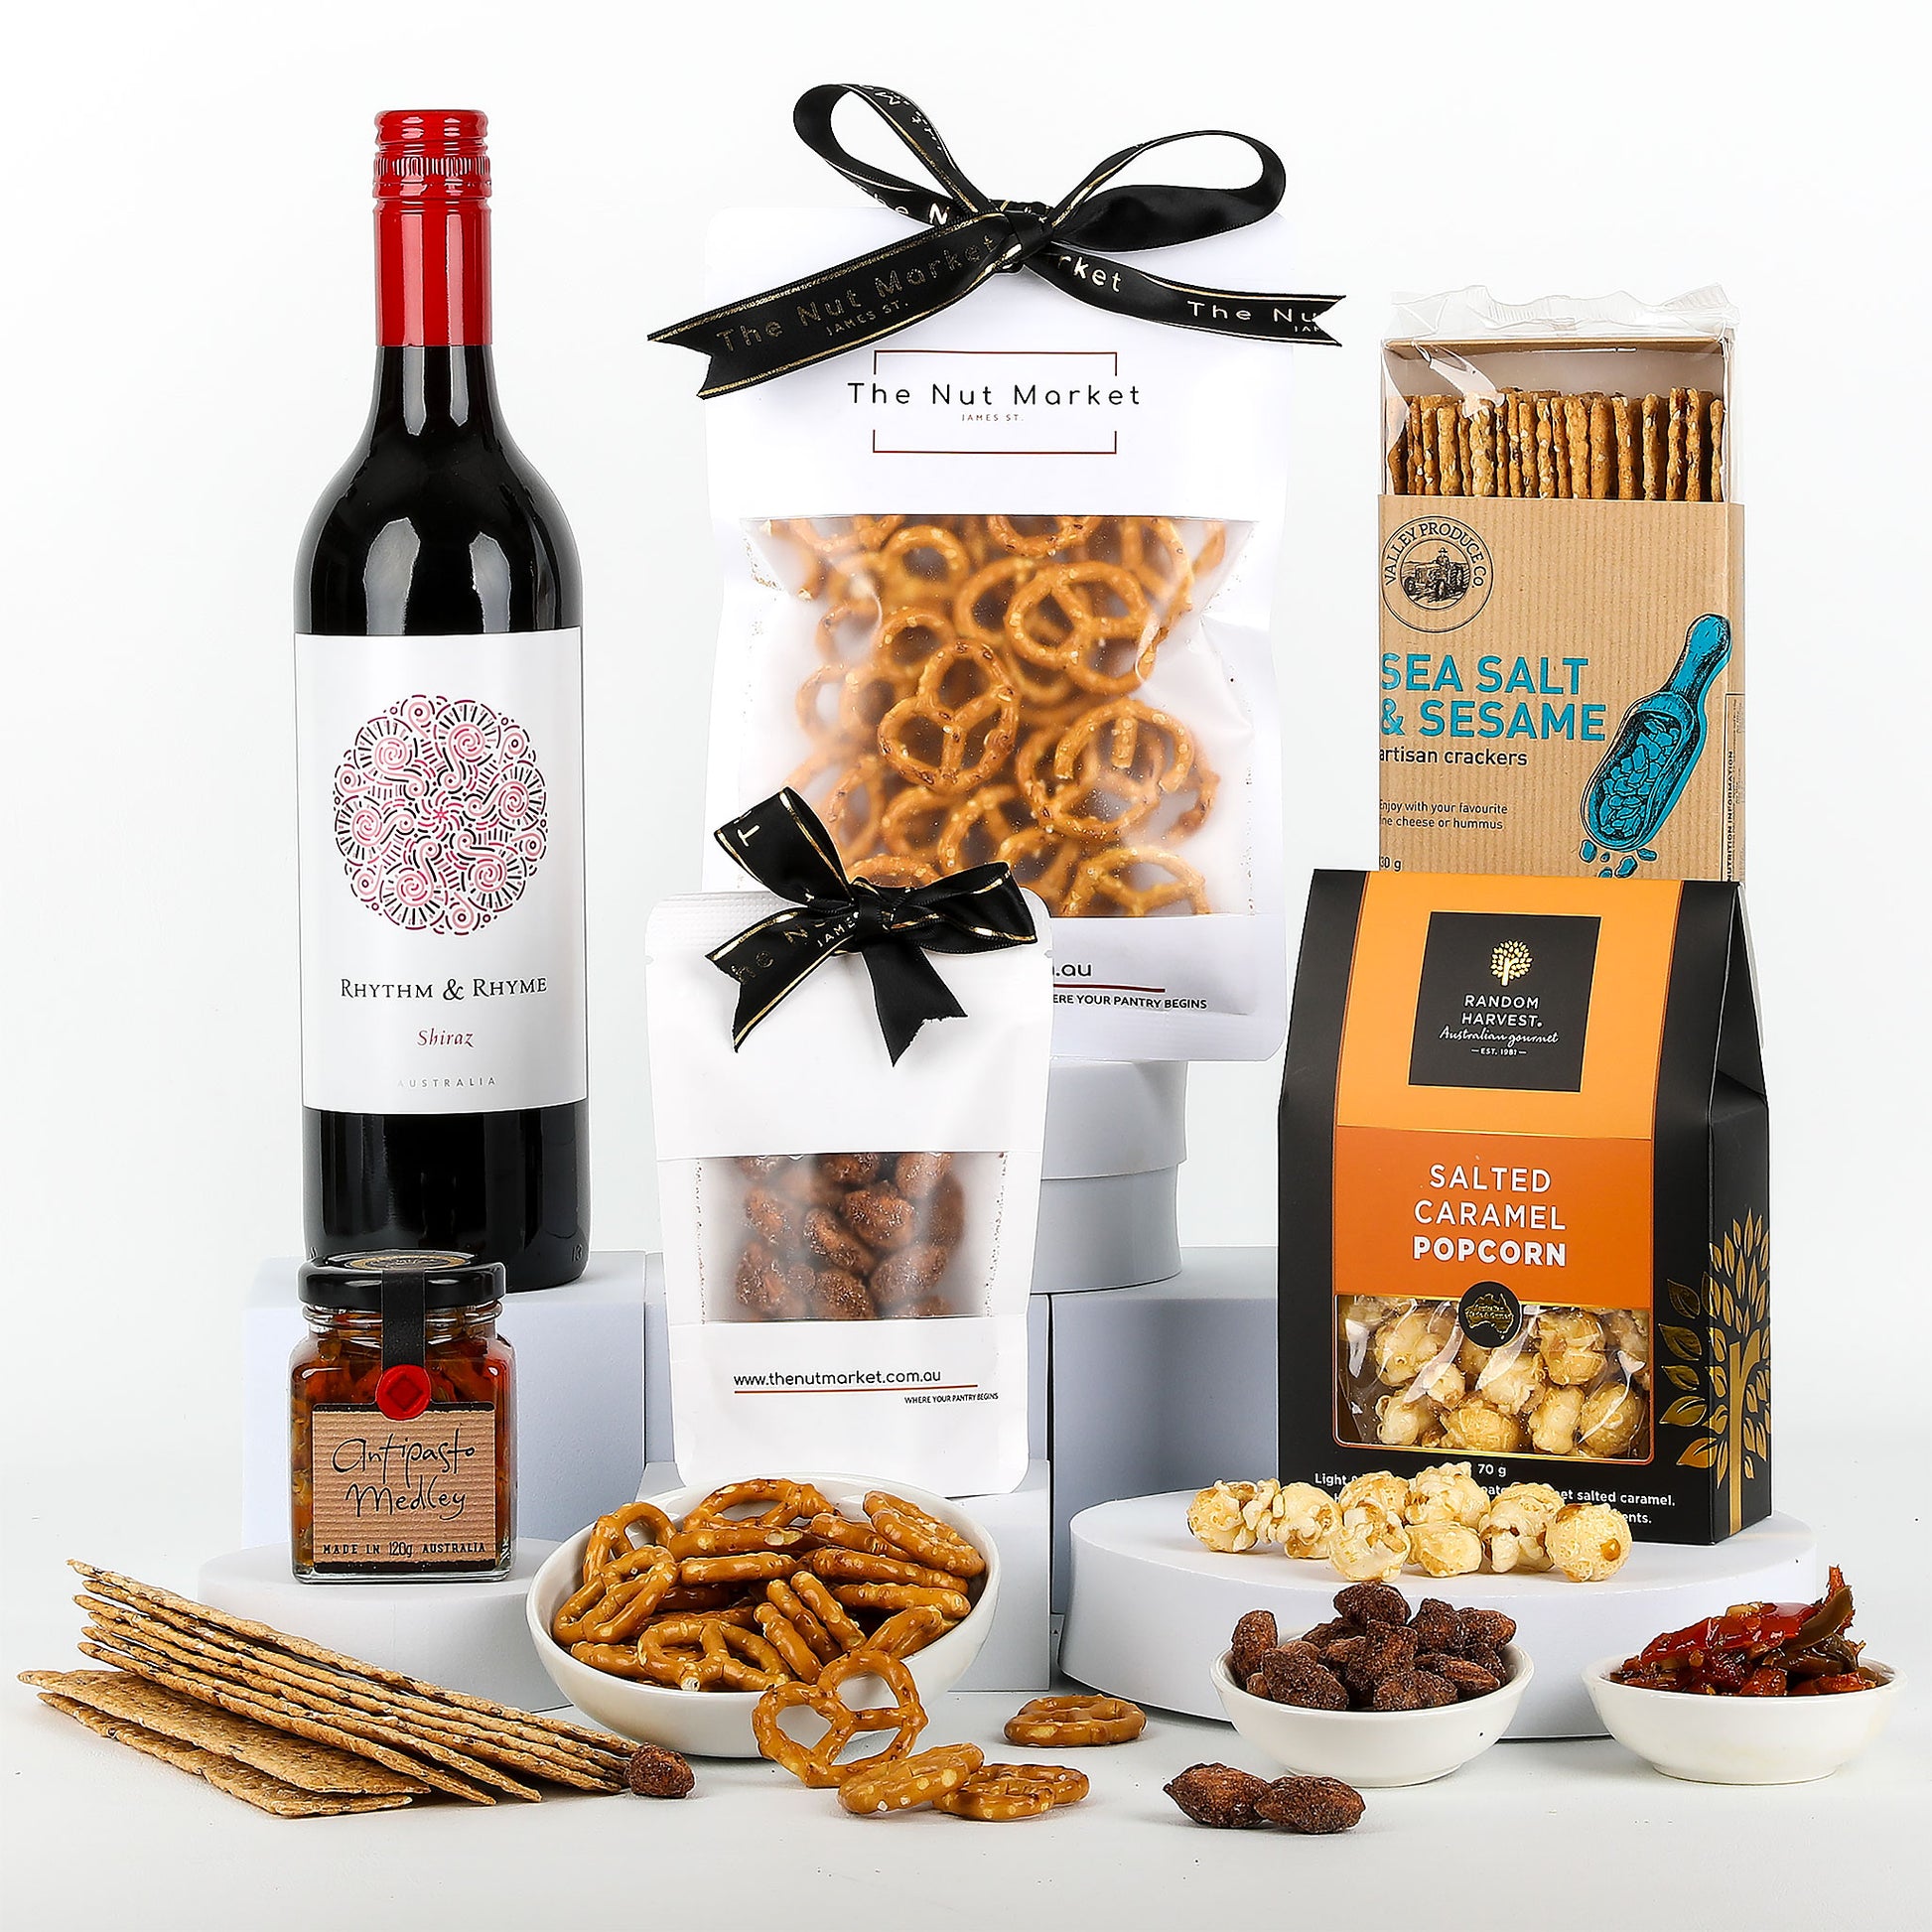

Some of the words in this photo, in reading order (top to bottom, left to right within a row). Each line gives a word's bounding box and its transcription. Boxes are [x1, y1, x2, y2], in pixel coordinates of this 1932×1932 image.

[715, 321, 784, 351] The
[796, 289, 862, 327] Nut
[875, 234, 996, 299] Market
[1186, 300, 1252, 321] The
[826, 310, 876, 337] JAMES
[847, 382, 910, 404] The
[932, 383, 993, 405] Nut
[1014, 384, 1141, 405] Market
[961, 413, 999, 422] JAMES
[1384, 526, 1419, 586] VALLEY
[1419, 521, 1485, 564] PRODUCE
[1381, 652, 1463, 692] SEA
[1476, 655, 1588, 695] SALT
[1381, 697, 1406, 736] &
[1419, 699, 1606, 741] SESAME
[1379, 746, 1438, 763] artisan
[1444, 748, 1528, 765] crackers
[1405, 800, 1428, 811] with
[1431, 803, 1455, 814] your
[1458, 802, 1508, 814] favourite
[1396, 816, 1435, 827] cheese
[1438, 819, 1450, 828] or
[1452, 818, 1503, 829] hummus
[1394, 860, 1402, 872] g
[442, 978, 465, 1001] &
[1076, 995, 1111, 1006] YOUR
[1114, 997, 1165, 1009] PANTRY
[1165, 999, 1207, 1010] BEGINS
[1464, 995, 1540, 1009] RANDOM
[417, 1028, 475, 1048] Shiraz
[1439, 1025, 1508, 1040] Australian
[1507, 1032, 1560, 1047] gourmet
[397, 1076, 497, 1088] AUSTRALIA
[1430, 1164, 1552, 1193] SALTED
[1414, 1199, 1567, 1230] CARAMEL
[1413, 1235, 1567, 1267] POPCORN
[734, 1370, 941, 1386] www.thenutmarket.com.au
[903, 1395, 931, 1404] WHERE
[977, 1392, 999, 1401] BEGINS
[1477, 1464, 1494, 1475] 70
[1498, 1465, 1507, 1478] g
[345, 1474, 466, 1521] Medley
[1314, 1472, 1347, 1487] Light
[1577, 1489, 1616, 1503] salted
[1620, 1494, 1676, 1507] caramel.
[323, 1543, 358, 1555] MADE
[365, 1544, 380, 1554] IN
[388, 1541, 413, 1558] 120g
[422, 1542, 485, 1554] AUSTRALIA
